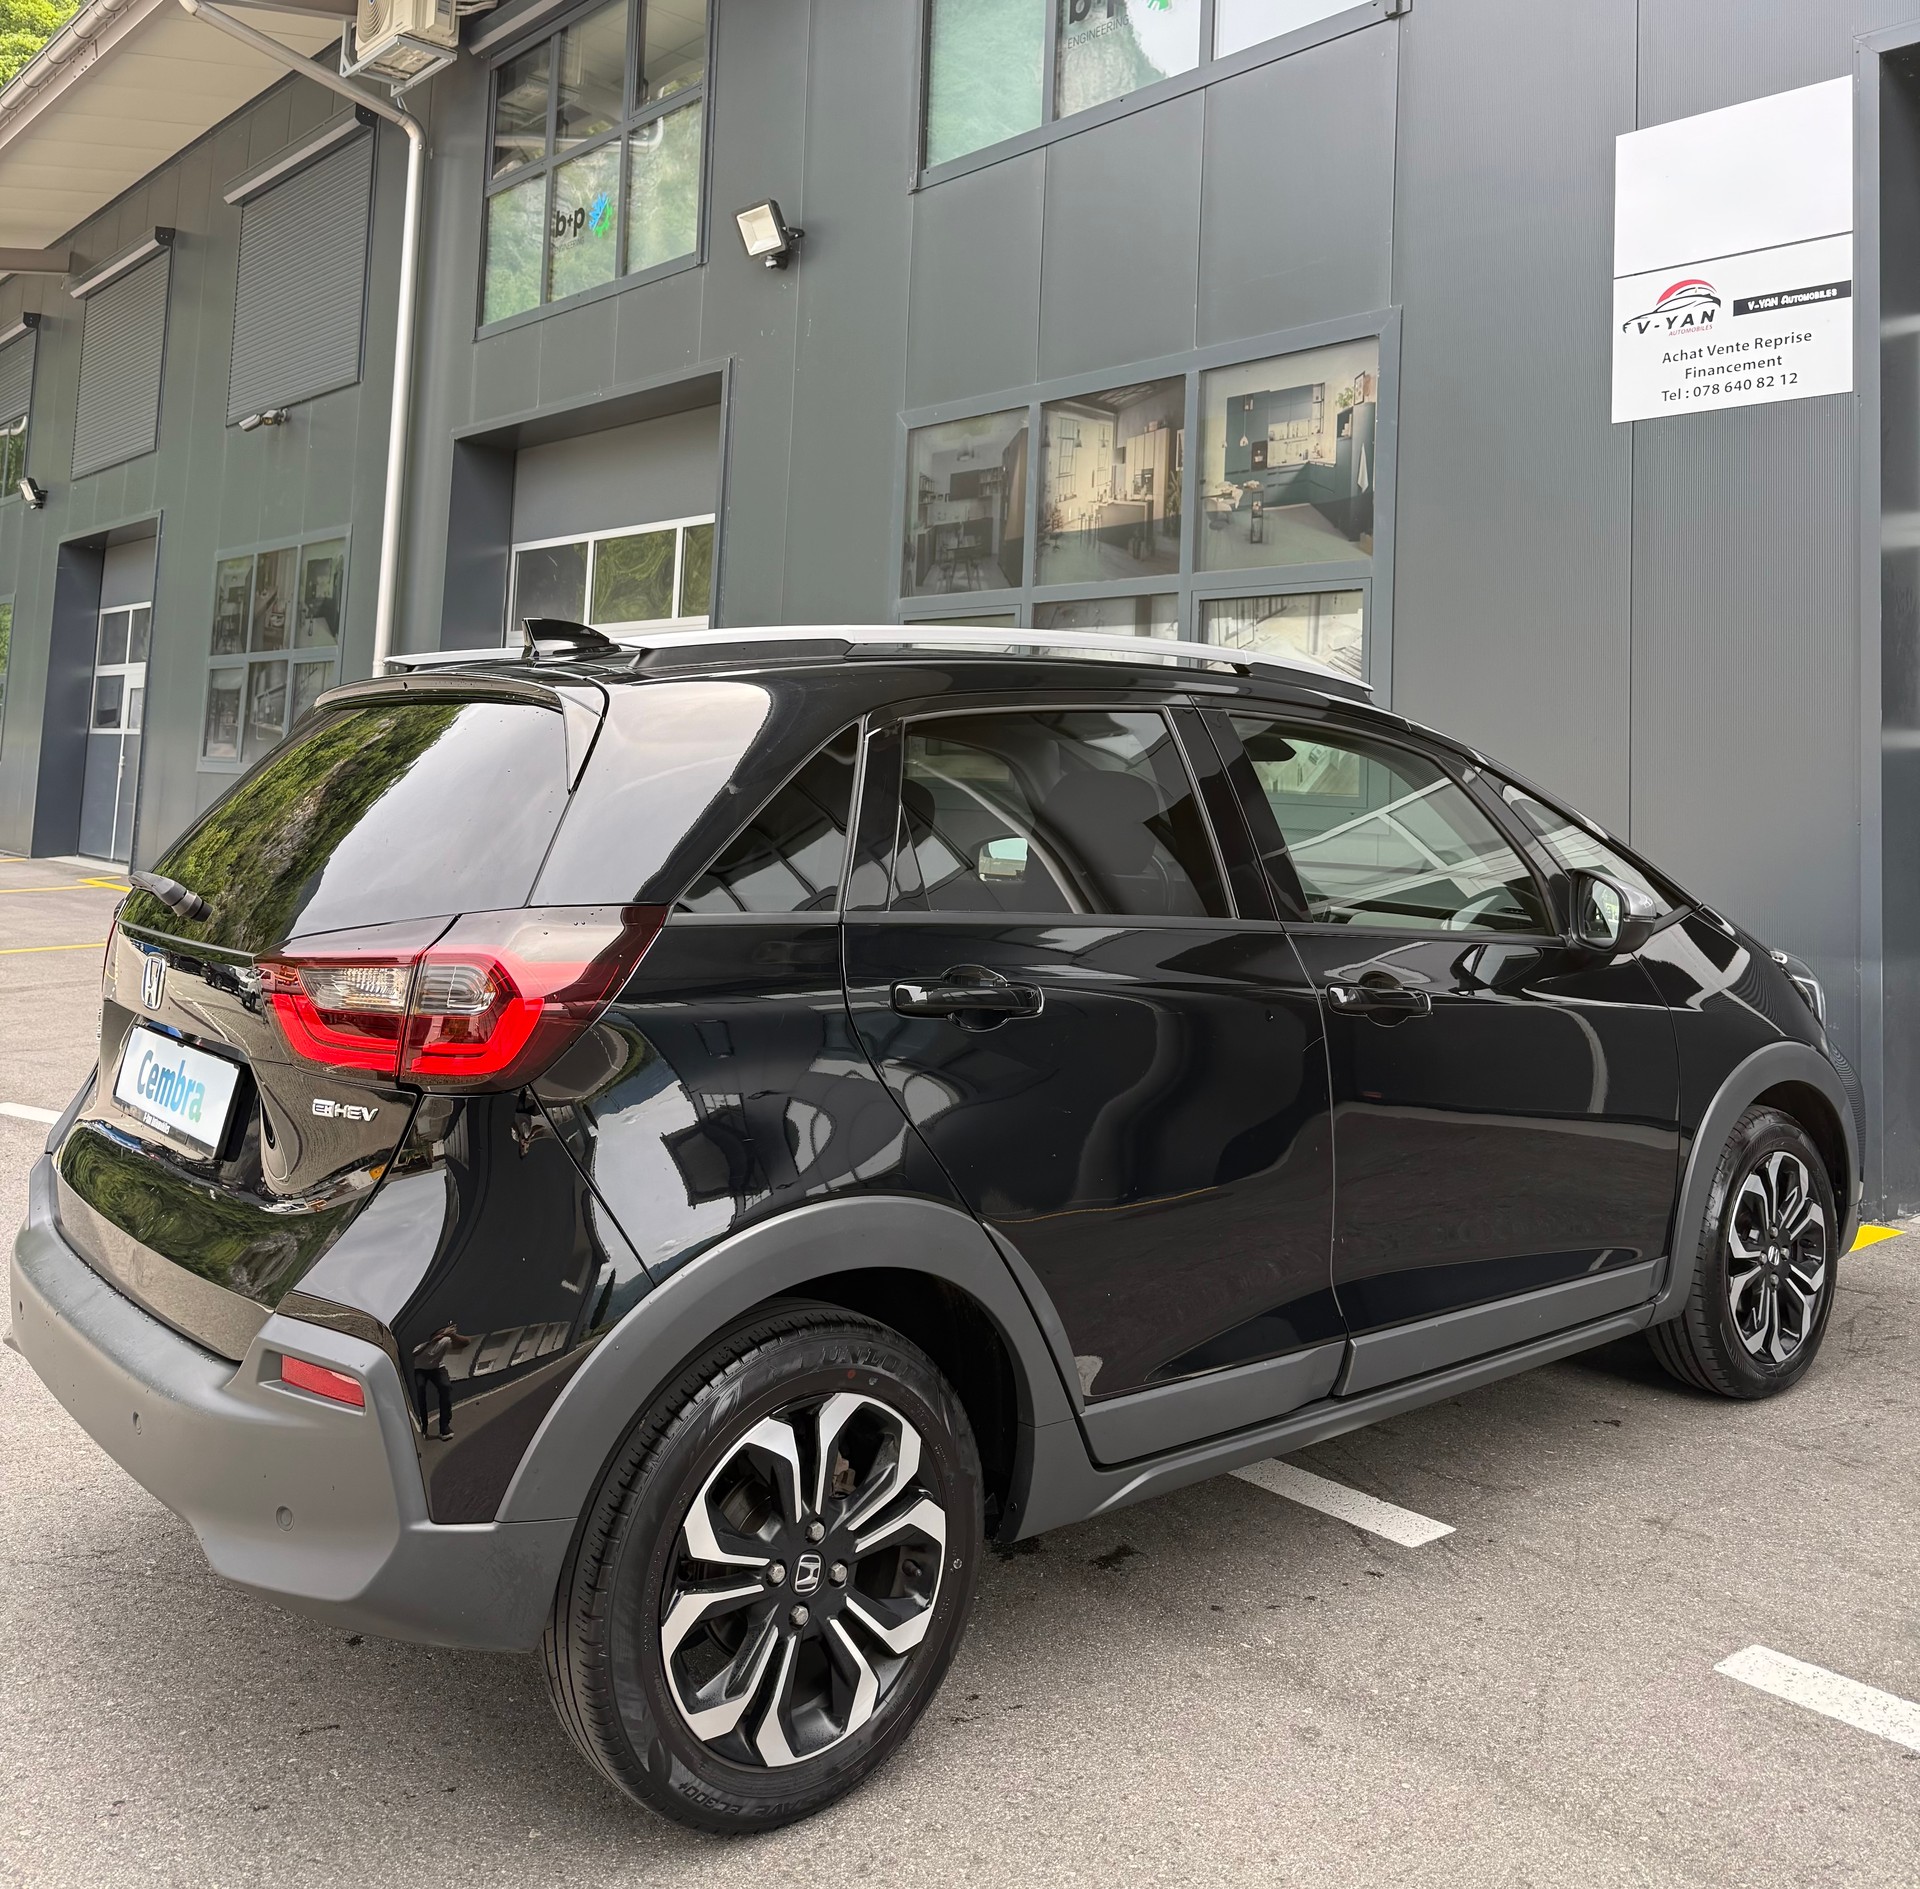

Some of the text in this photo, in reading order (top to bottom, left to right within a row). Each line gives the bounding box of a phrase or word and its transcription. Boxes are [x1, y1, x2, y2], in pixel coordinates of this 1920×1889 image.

[1067, 14, 1129, 49] ENGINEERING
[555, 207, 585, 237] b+p
[1747, 296, 1779, 311] V-YAN
[1637, 309, 1716, 335] V-YAN
[1668, 324, 1713, 337] AUTOMOBILES
[1661, 331, 1813, 364] Achat Vente Reprise
[1684, 355, 1783, 380] Financement
[1661, 388, 1682, 402] Tel
[1693, 383, 1721, 398] 078
[1724, 379, 1753, 394] 640
[1756, 375, 1776, 389] 82
[1780, 372, 1799, 386] 12
[136, 1049, 206, 1123] Cembra
